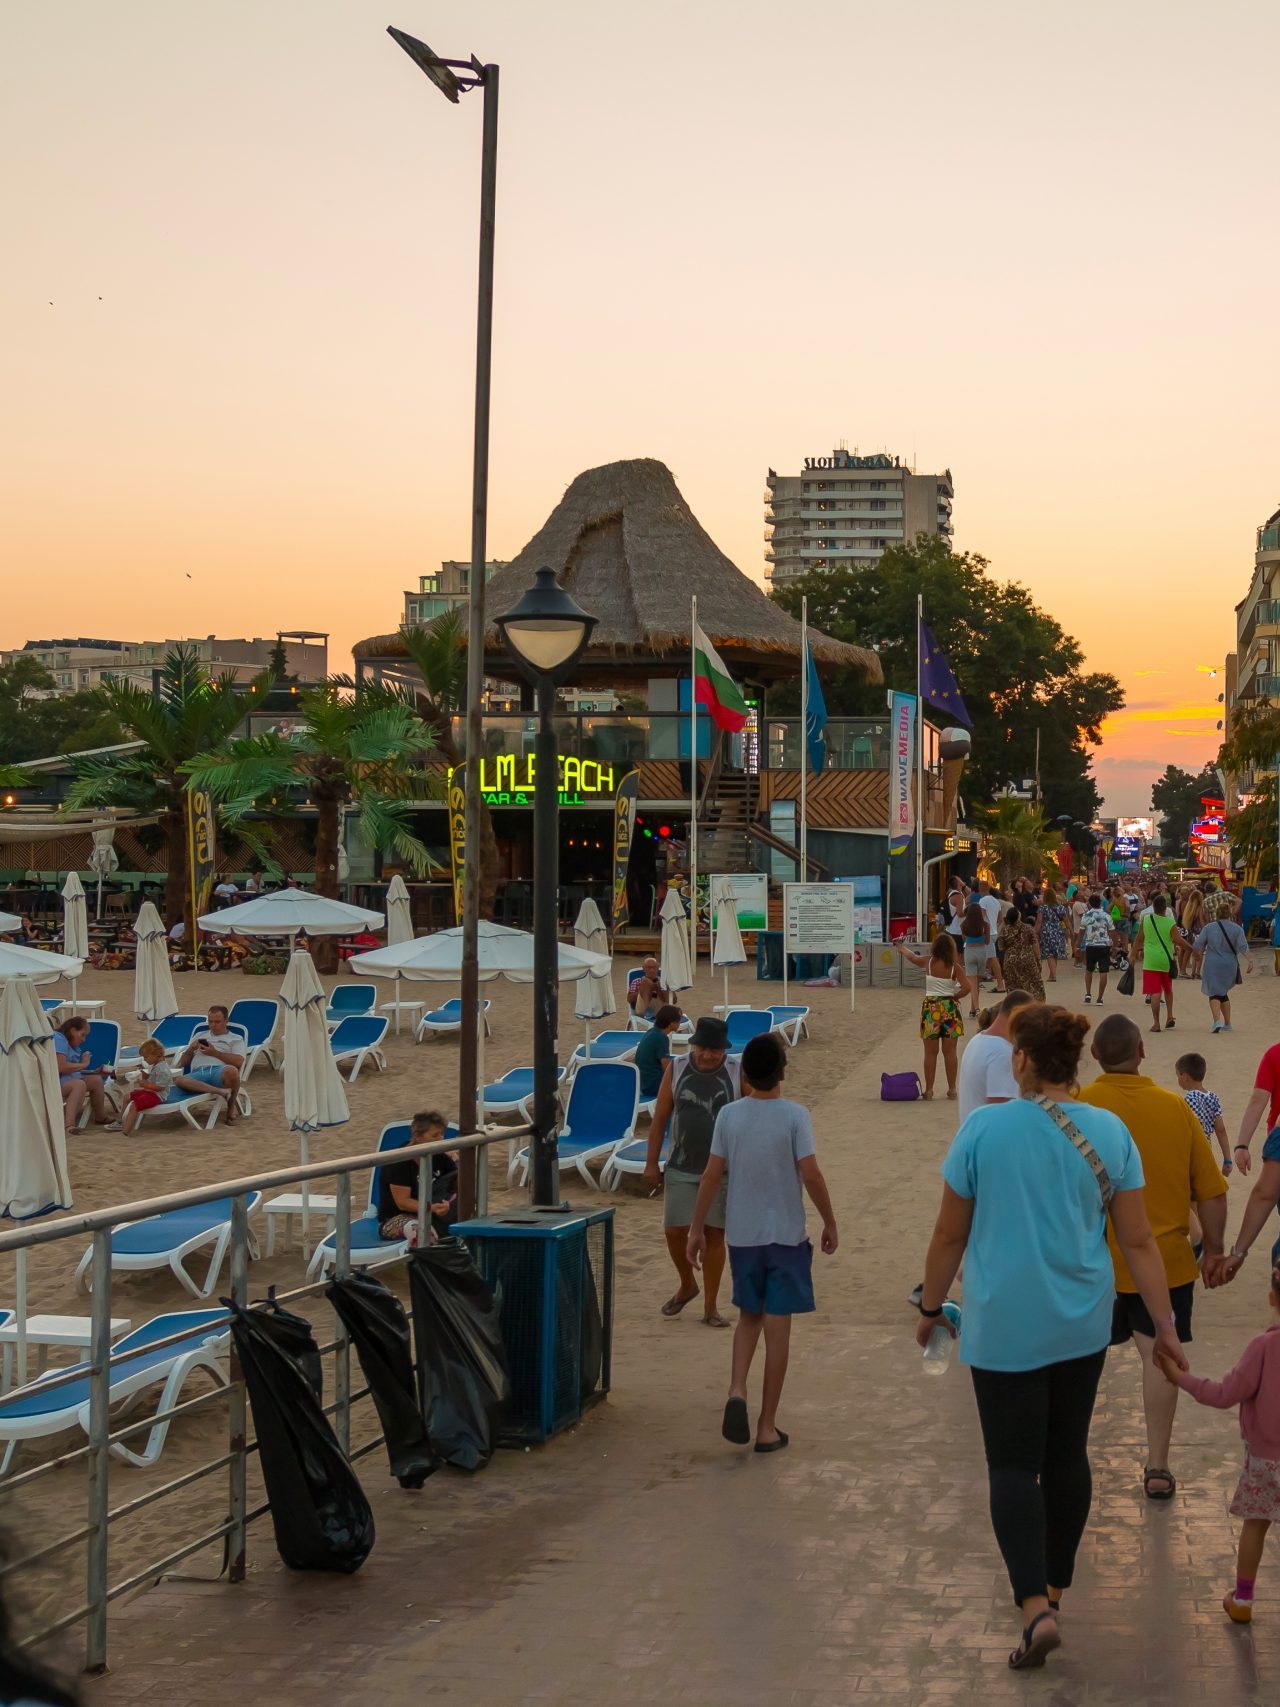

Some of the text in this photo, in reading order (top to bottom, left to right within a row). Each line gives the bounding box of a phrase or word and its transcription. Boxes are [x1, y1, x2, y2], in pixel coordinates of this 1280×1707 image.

[898, 705, 910, 801] WAVEMEDIA
[482, 793, 510, 804] AR
[515, 793, 528, 804] &
